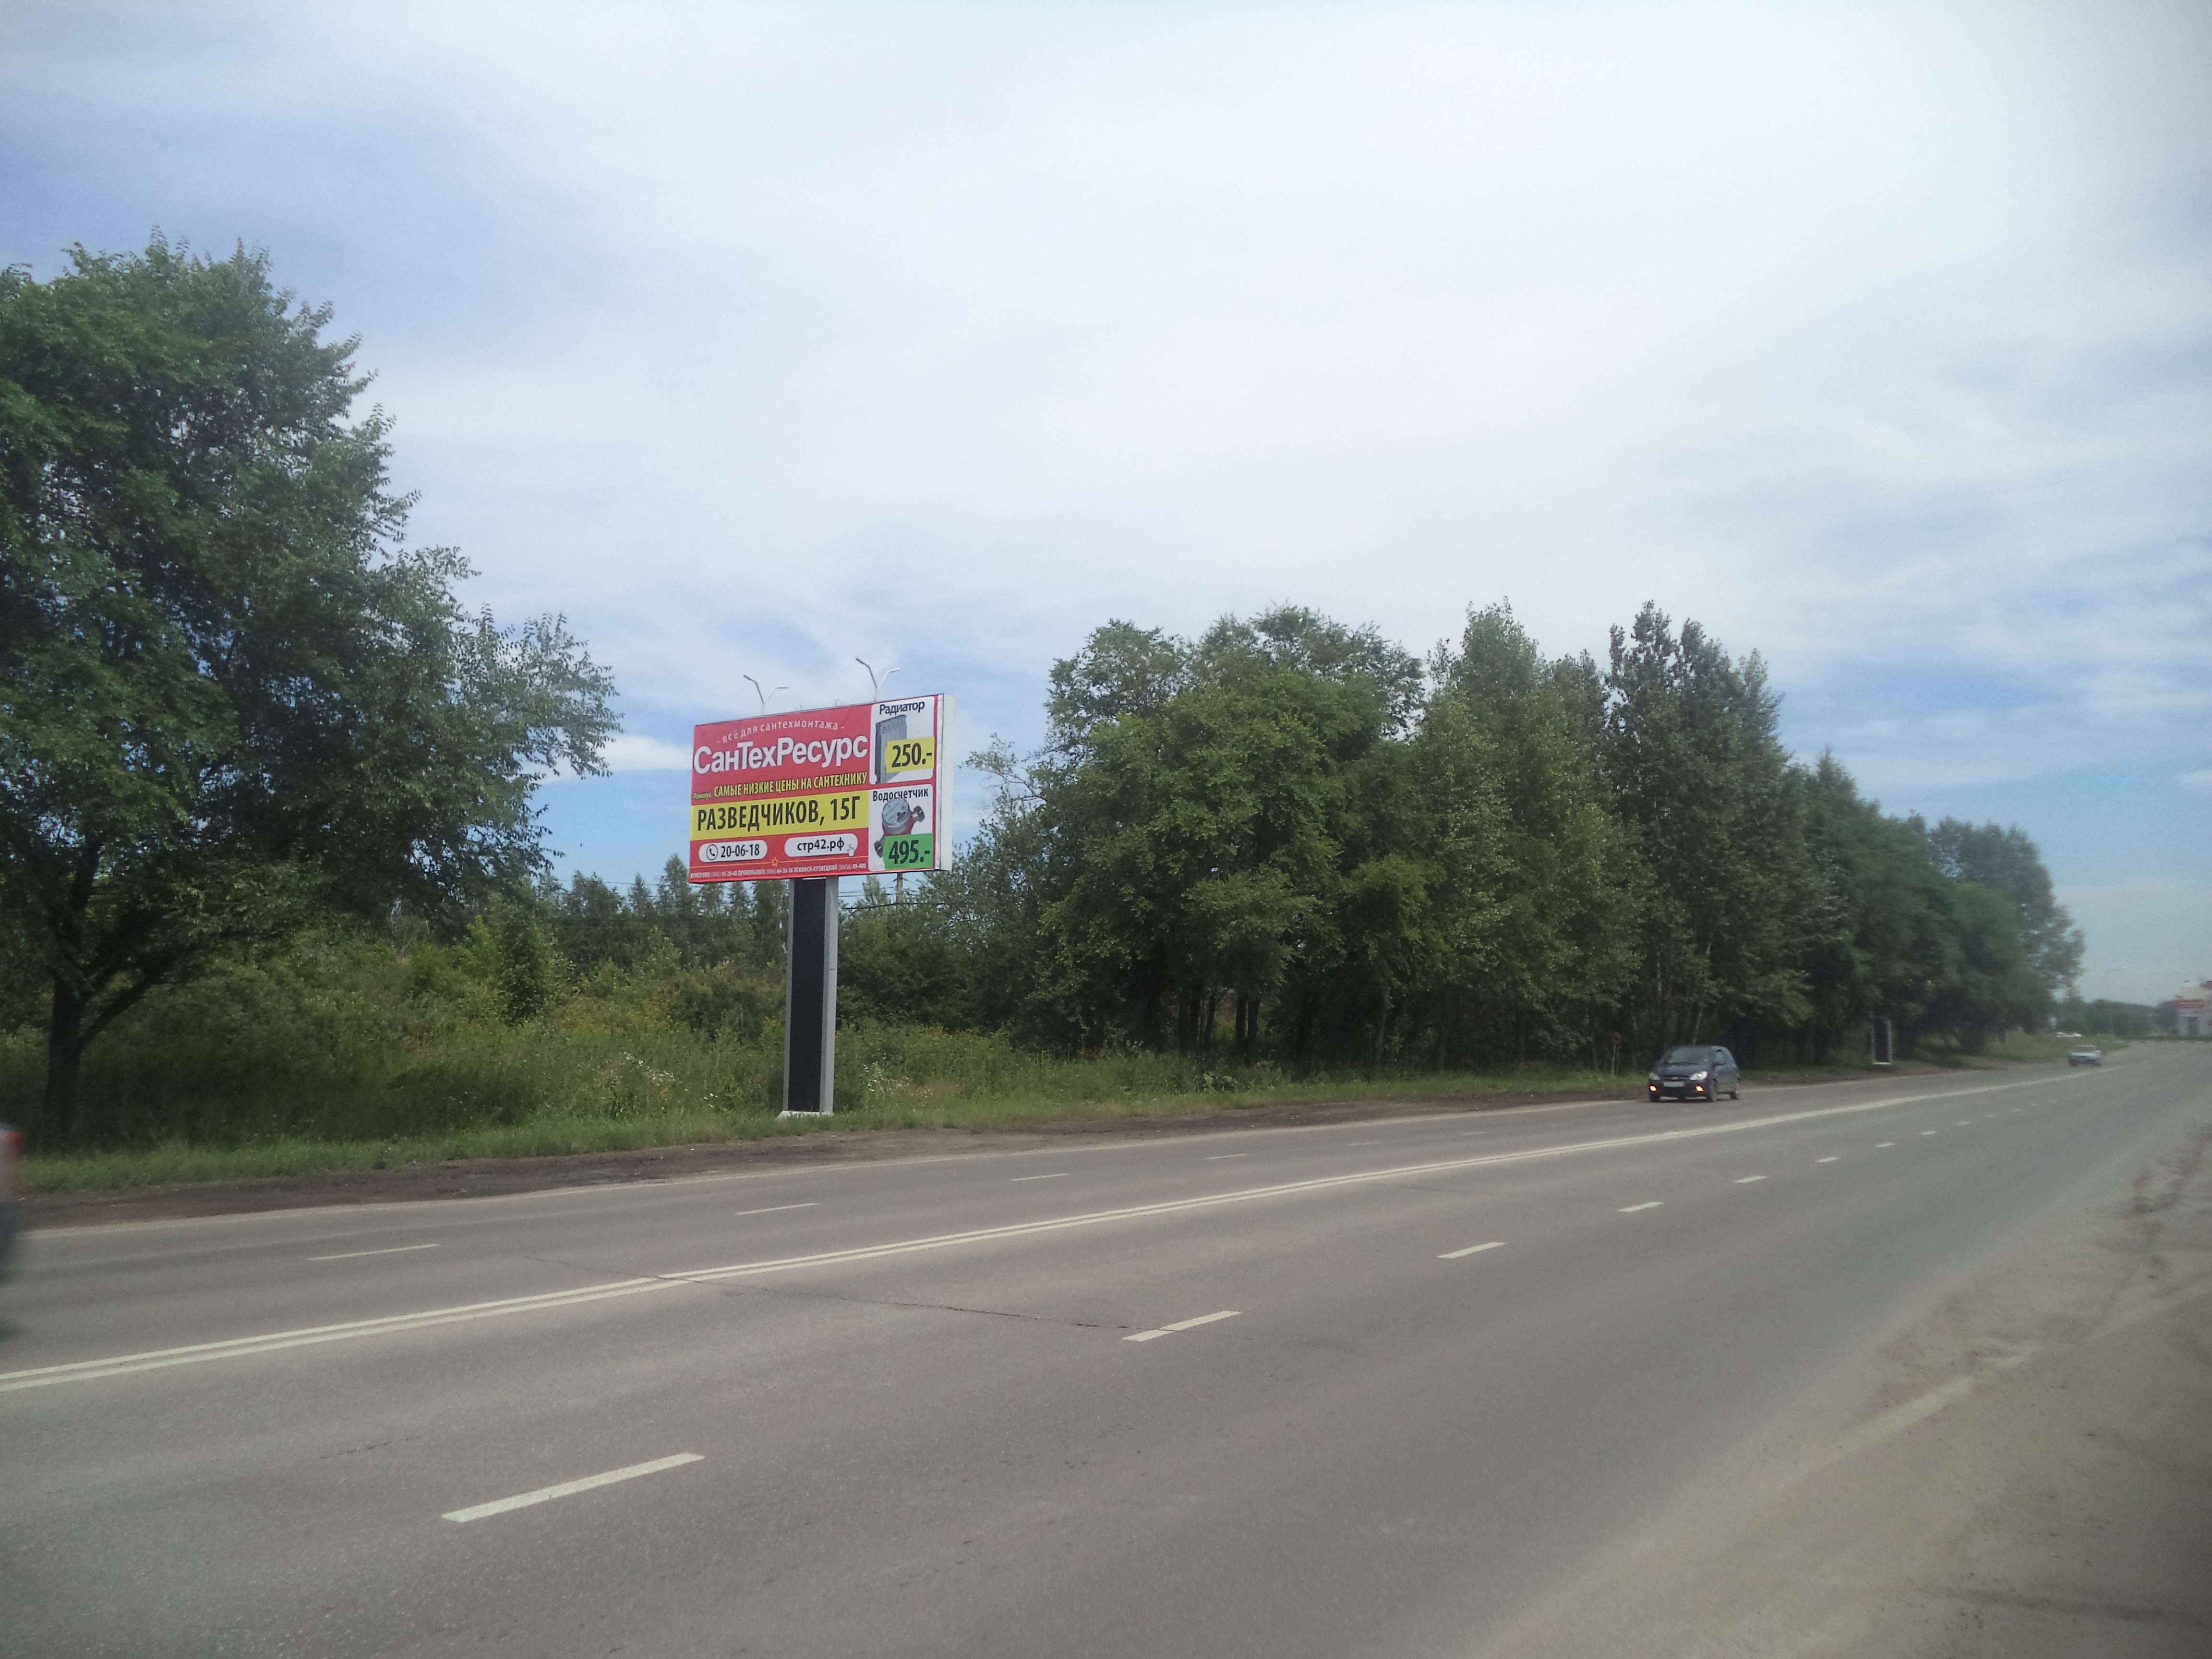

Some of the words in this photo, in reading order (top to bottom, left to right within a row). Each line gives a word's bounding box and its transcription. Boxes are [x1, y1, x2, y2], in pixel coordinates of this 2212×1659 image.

[879, 702, 925, 716] Радиатор
[722, 731, 739, 743] всё
[741, 726, 757, 738] для
[760, 720, 838, 732] сантехмонтажа
[694, 735, 868, 774] СанТехРесурс
[714, 783, 742, 797] САМЫЕ
[744, 781, 774, 795] НИЗКИЕ
[775, 777, 799, 794] ЦЕНЫ
[801, 777, 811, 790] НА
[814, 771, 868, 788] САНТЕХНИКУ
[873, 788, 929, 803] Водосчетчик
[697, 800, 824, 831] РАЗВЕДЧИКОВ,
[830, 795, 861, 821] 15Г
[721, 843, 760, 858] 20-06-18
[797, 837, 845, 853] стр42.рф
